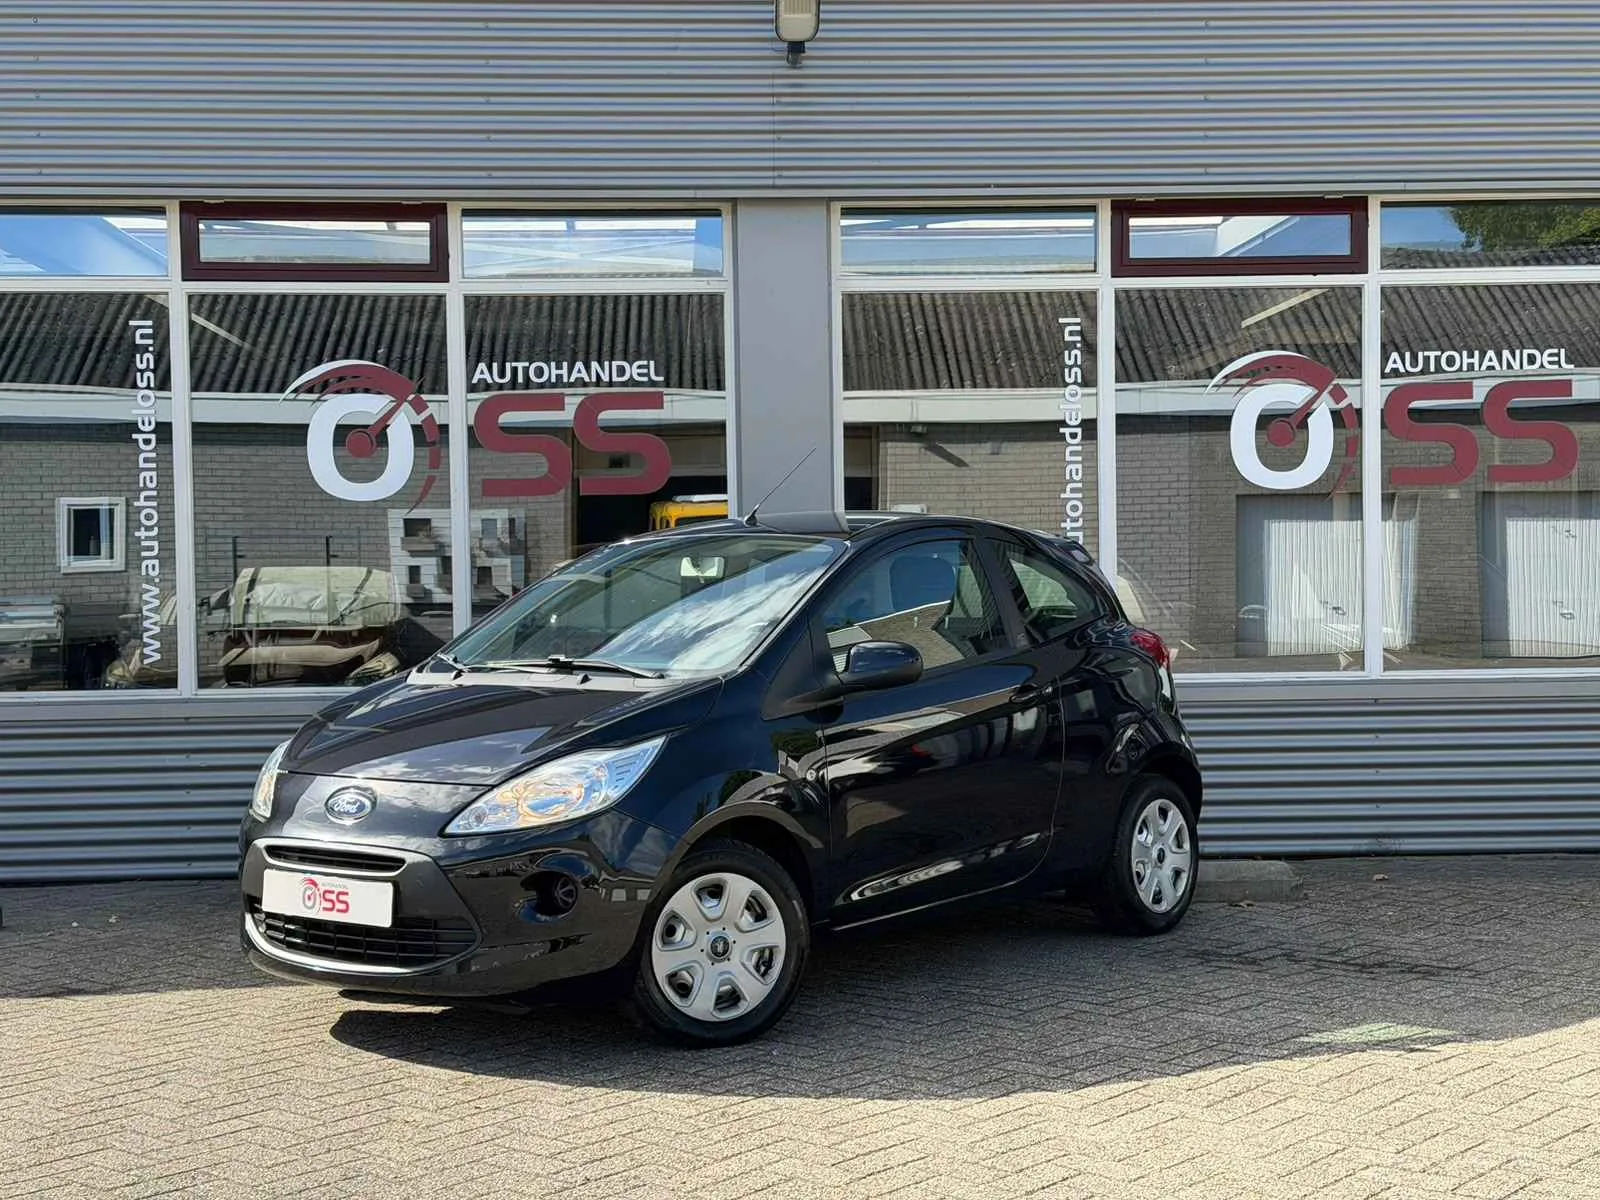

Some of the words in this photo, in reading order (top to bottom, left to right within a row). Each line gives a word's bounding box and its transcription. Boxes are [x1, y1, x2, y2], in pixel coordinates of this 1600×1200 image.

[471, 359, 665, 384] AUTOHANDEL
[1384, 348, 1575, 373] AUTOHANDEL
[306, 390, 672, 502] OSS
[1230, 379, 1579, 490] OSS
[128, 319, 162, 666] www.autohandeloss.nl
[328, 798, 361, 814] Ford
